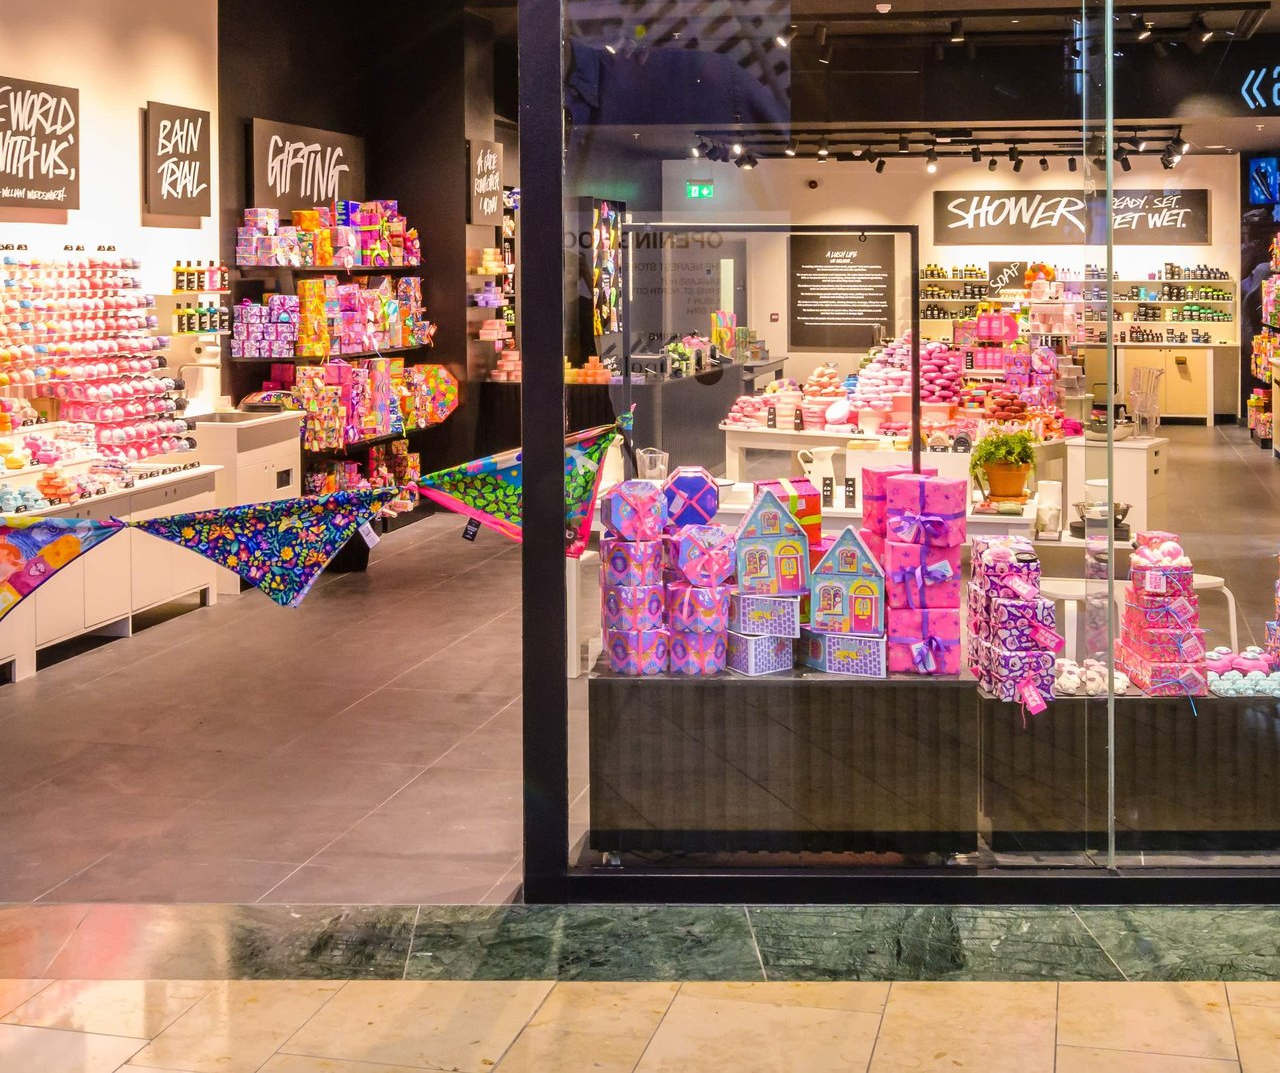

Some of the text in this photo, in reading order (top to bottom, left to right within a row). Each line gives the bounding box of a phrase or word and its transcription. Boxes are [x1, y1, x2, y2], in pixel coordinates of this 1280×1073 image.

[10, 90, 76, 135] WORLD
[157, 117, 202, 156] BAIN
[267, 135, 349, 203] GIFTING
[947, 194, 1085, 233] SHOWER
[1152, 195, 1181, 208] SET.
[1112, 209, 1191, 230] ET WET.
[990, 262, 1020, 294] SOAP
